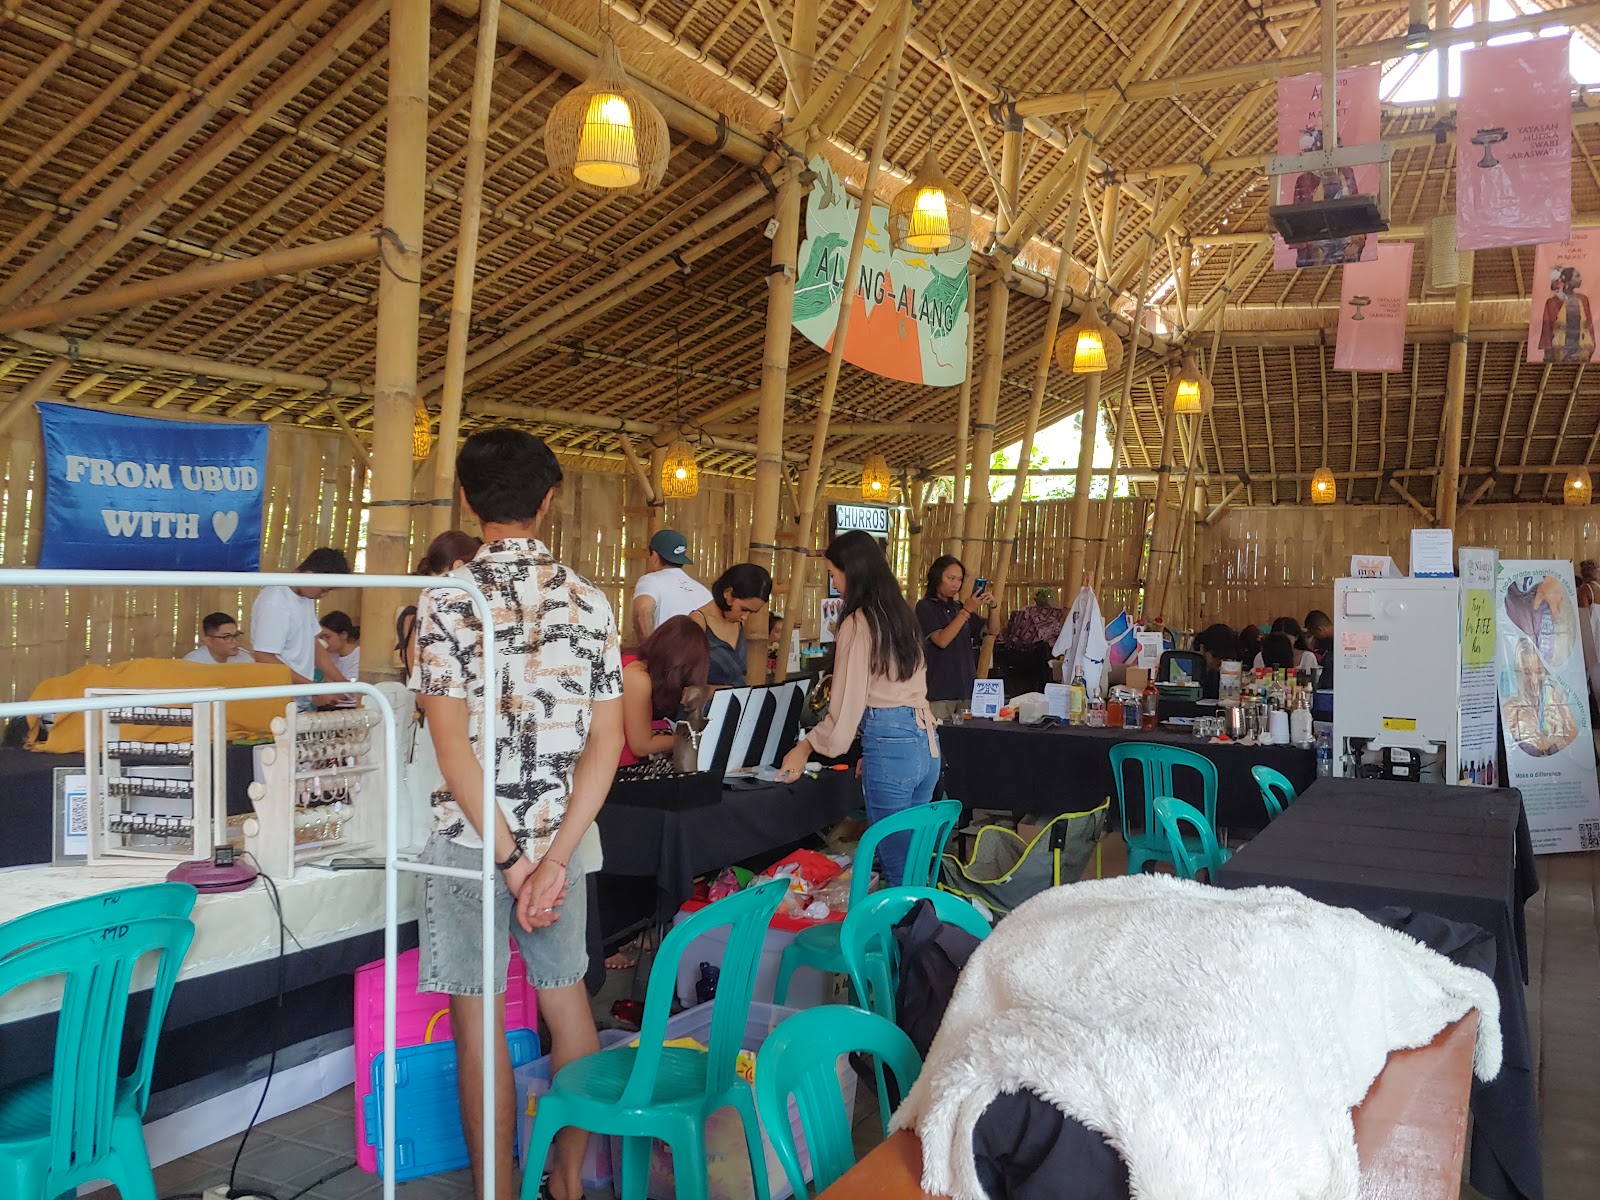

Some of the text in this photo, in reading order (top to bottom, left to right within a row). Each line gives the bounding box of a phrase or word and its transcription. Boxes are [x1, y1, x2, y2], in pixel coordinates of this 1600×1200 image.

[1518, 123, 1559, 134] YAYASAN
[1522, 131, 1559, 142] MUDRA
[815, 247, 954, 332] ALNG-ALANG
[65, 455, 259, 492] FROM UBUD
[101, 509, 200, 539] WITH
[836, 506, 886, 530] CHURROS
[101, 925, 129, 940] MD
